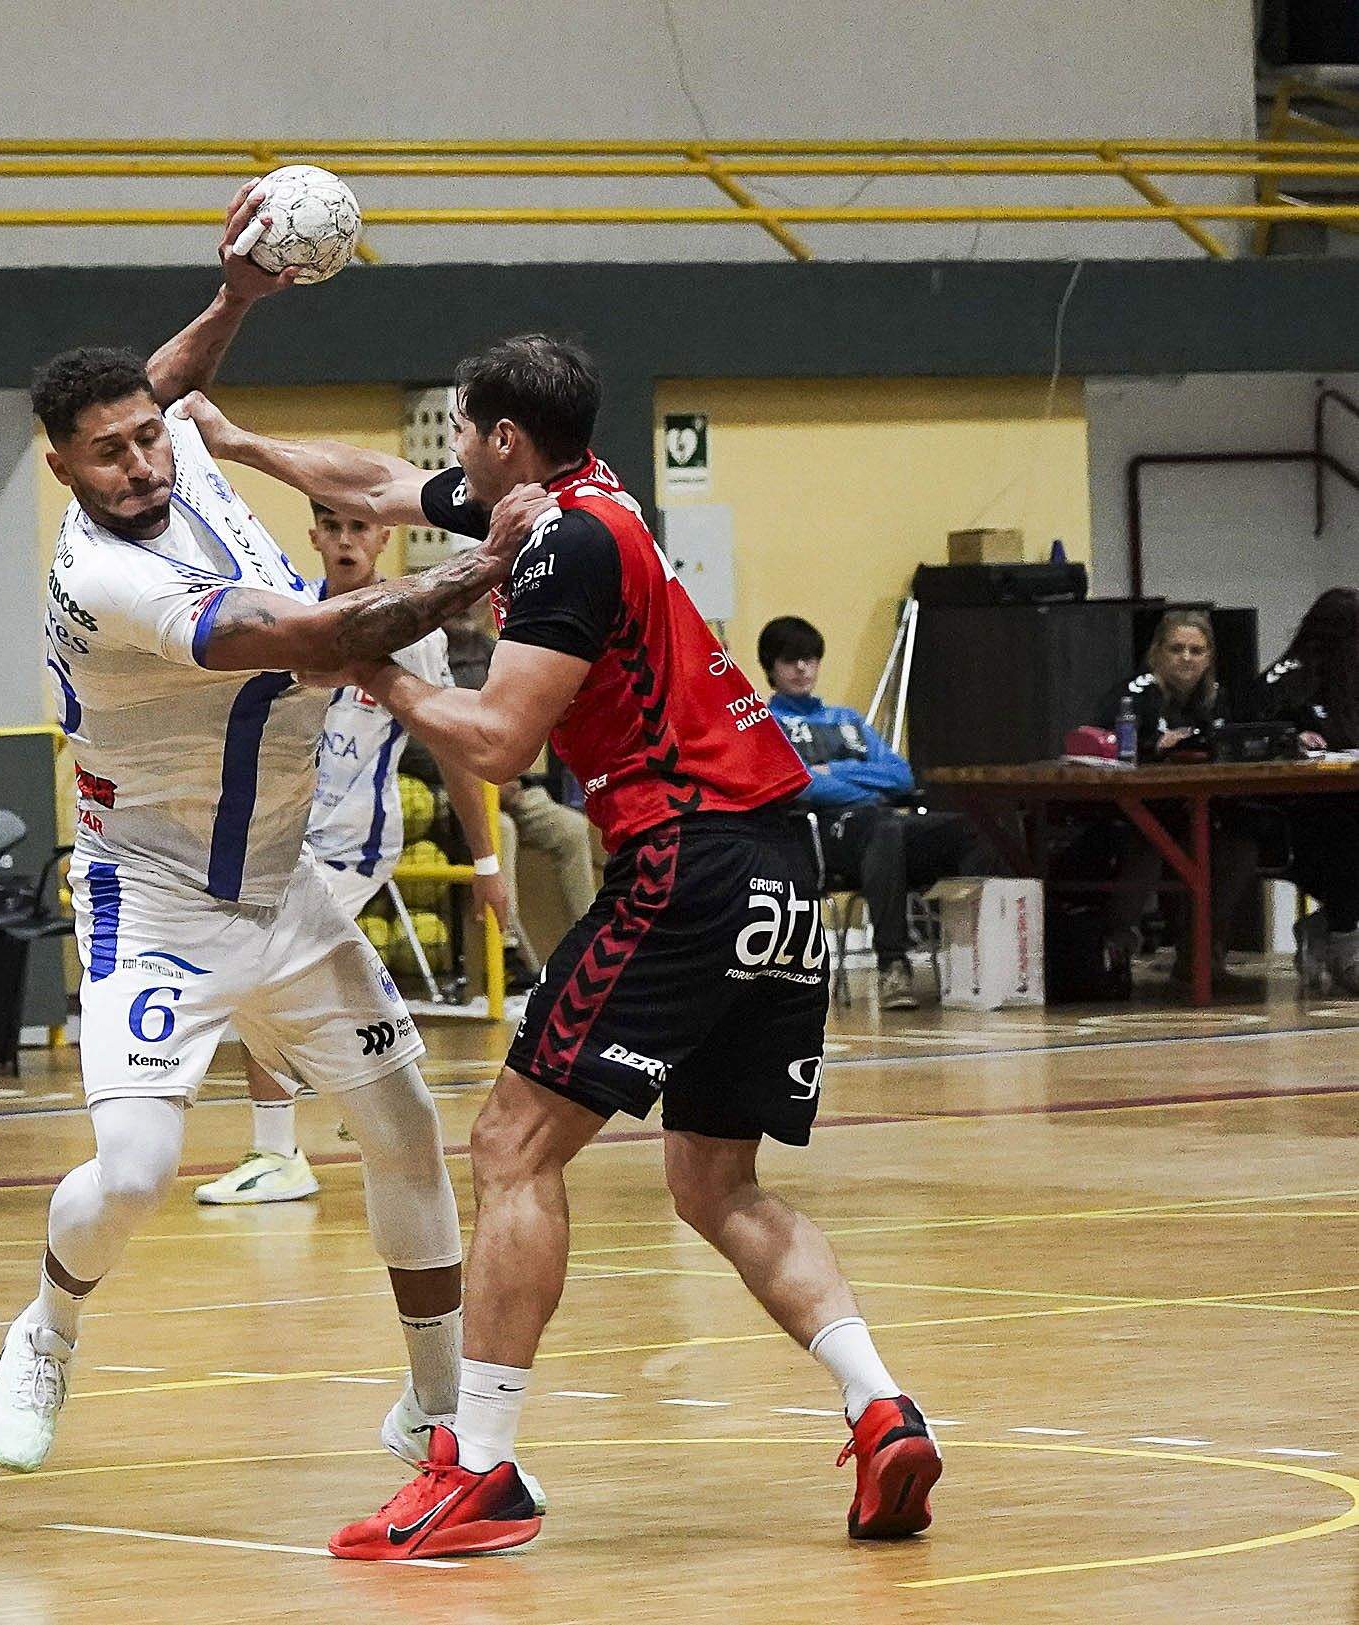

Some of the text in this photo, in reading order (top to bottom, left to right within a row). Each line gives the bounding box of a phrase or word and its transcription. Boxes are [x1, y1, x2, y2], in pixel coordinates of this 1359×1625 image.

[734, 706, 774, 732] auto
[735, 880, 826, 970] atu
[128, 986, 183, 1043] 6
